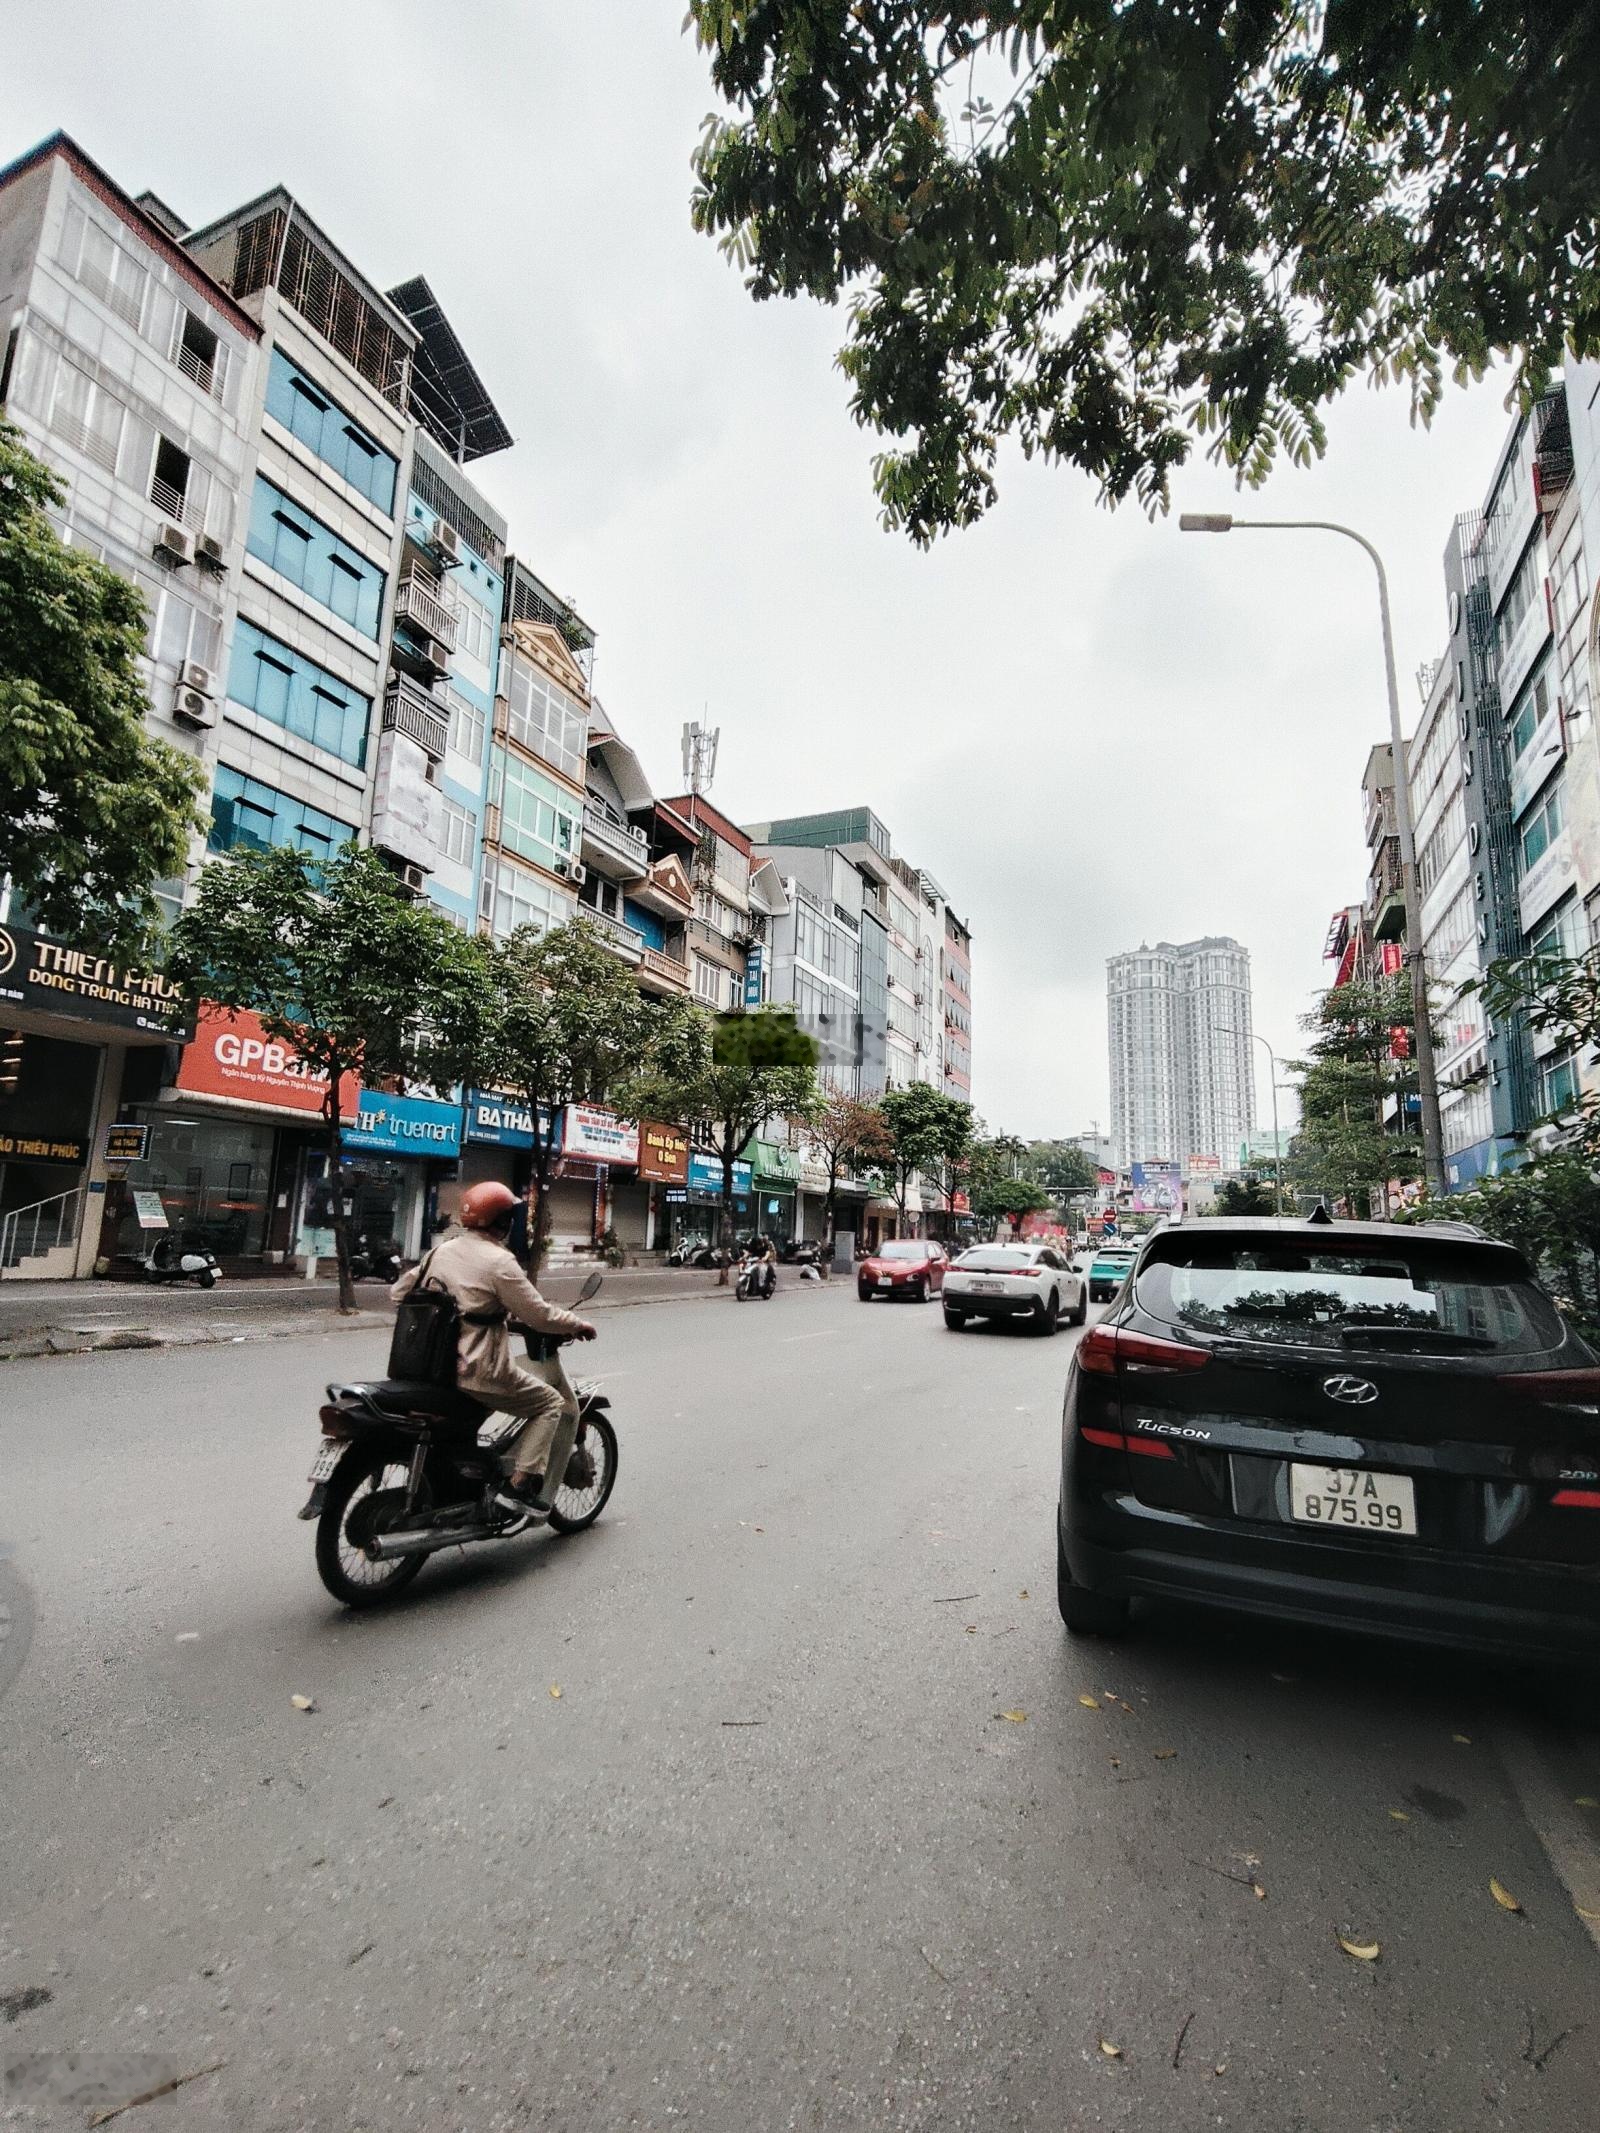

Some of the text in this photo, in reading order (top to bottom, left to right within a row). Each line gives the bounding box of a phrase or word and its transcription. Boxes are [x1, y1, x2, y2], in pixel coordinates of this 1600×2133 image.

[76, 980, 130, 1005] TRUNG
[132, 994, 152, 1010] HA
[389, 1113, 457, 1143] truemart
[1136, 1418, 1212, 1440] TUCSON
[1325, 1468, 1378, 1499] 37A
[1305, 1494, 1403, 1530] 875.99
